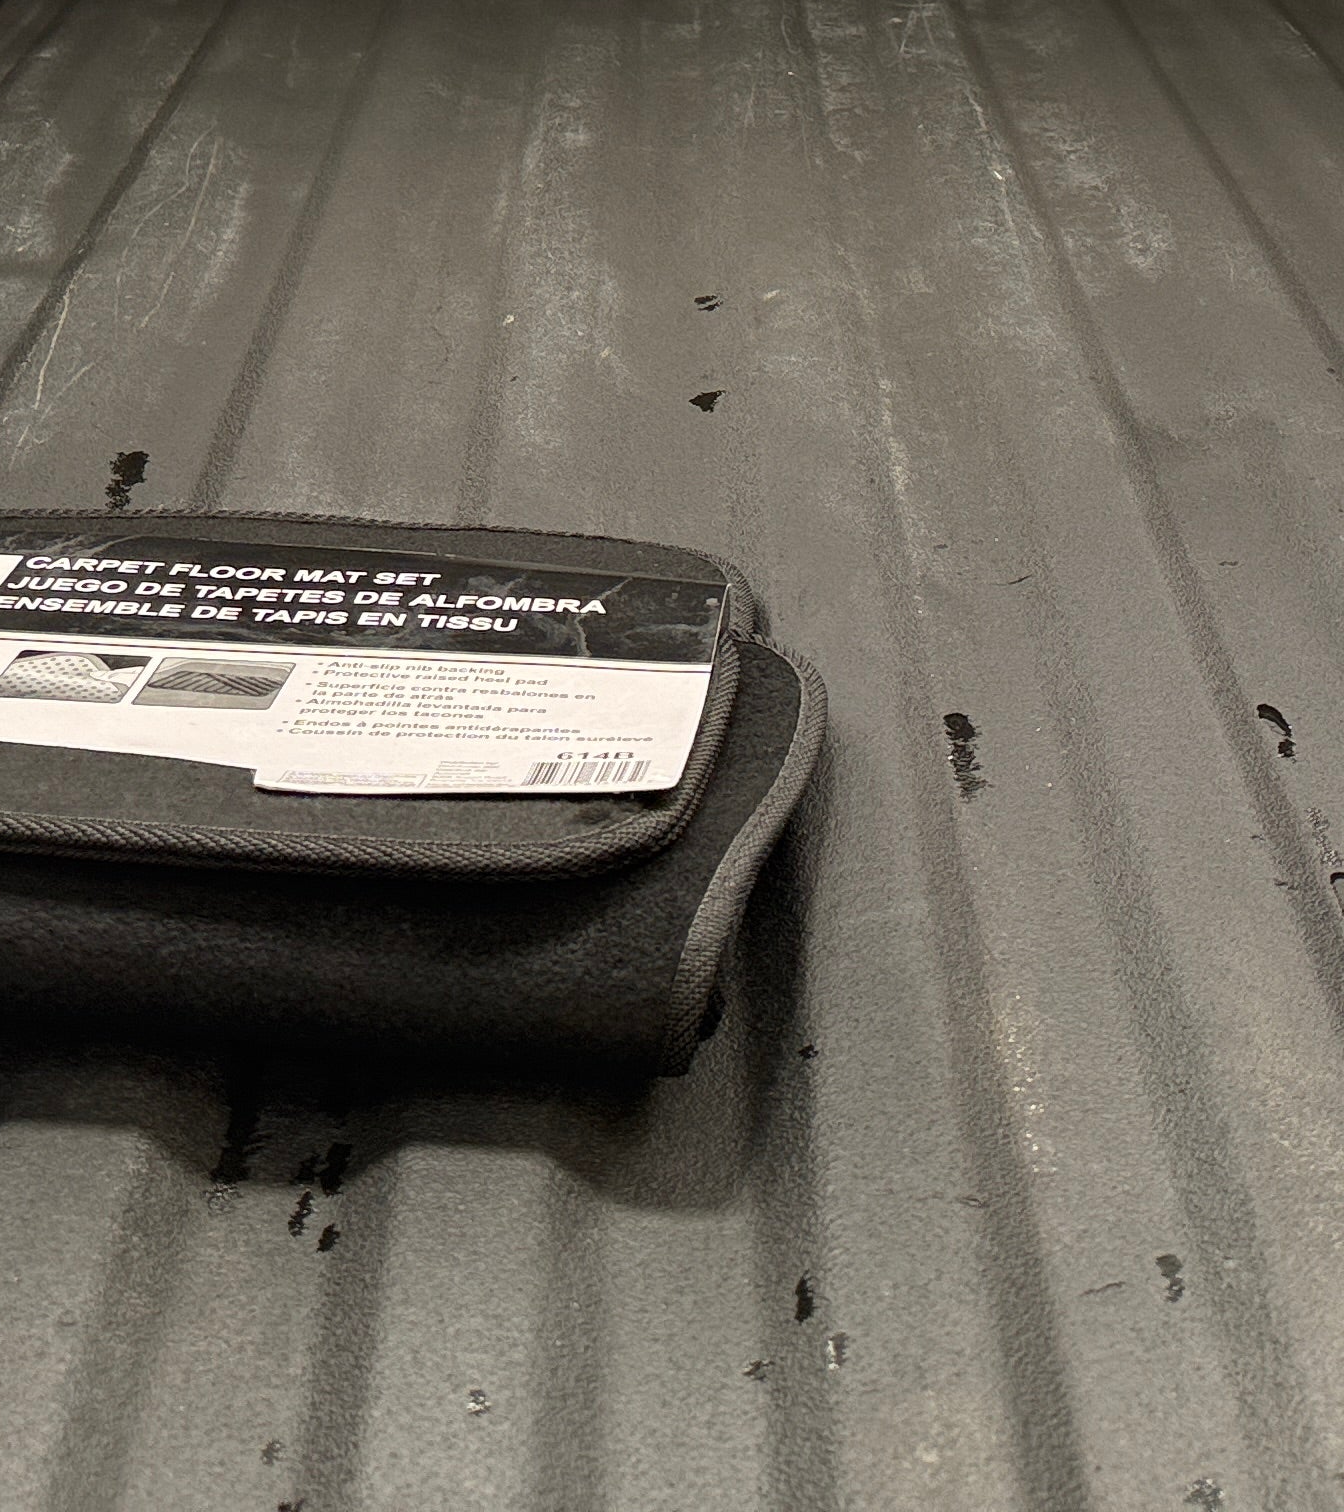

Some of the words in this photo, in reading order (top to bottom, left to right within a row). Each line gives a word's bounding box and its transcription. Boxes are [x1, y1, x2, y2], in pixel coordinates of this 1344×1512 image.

[26, 556, 165, 576] CARPET
[169, 563, 288, 582] FLOOR
[293, 568, 368, 585] MAT
[373, 572, 442, 587] SET
[7, 576, 131, 595] JUEGO
[134, 582, 185, 598] DE
[194, 585, 346, 606] TAPETES
[353, 591, 403, 606] DE
[408, 593, 607, 615] ALFOMBRA
[191, 605, 243, 622] DE
[252, 608, 349, 626] TAPIS
[356, 611, 407, 628] EN
[417, 614, 519, 633] TISSU
[327, 661, 401, 672] Anti-slip
[405, 663, 433, 672] nib
[437, 665, 505, 676] backing
[323, 669, 411, 680] Protective
[415, 673, 469, 683] raised
[474, 676, 511, 684] heel
[515, 678, 549, 686] pad
[316, 681, 406, 692] Superficie
[410, 686, 467, 694] contra
[471, 688, 569, 699] resbalones
[331, 690, 379, 699] parte
[298, 707, 376, 716] proteger
[306, 698, 412, 709] Almohadilla
[416, 702, 502, 712] levantada
[507, 706, 547, 714] para
[293, 719, 351, 728] Endos
[371, 721, 440, 730] pointes
[288, 727, 363, 737] Coussin
[395, 730, 490, 740] protection
